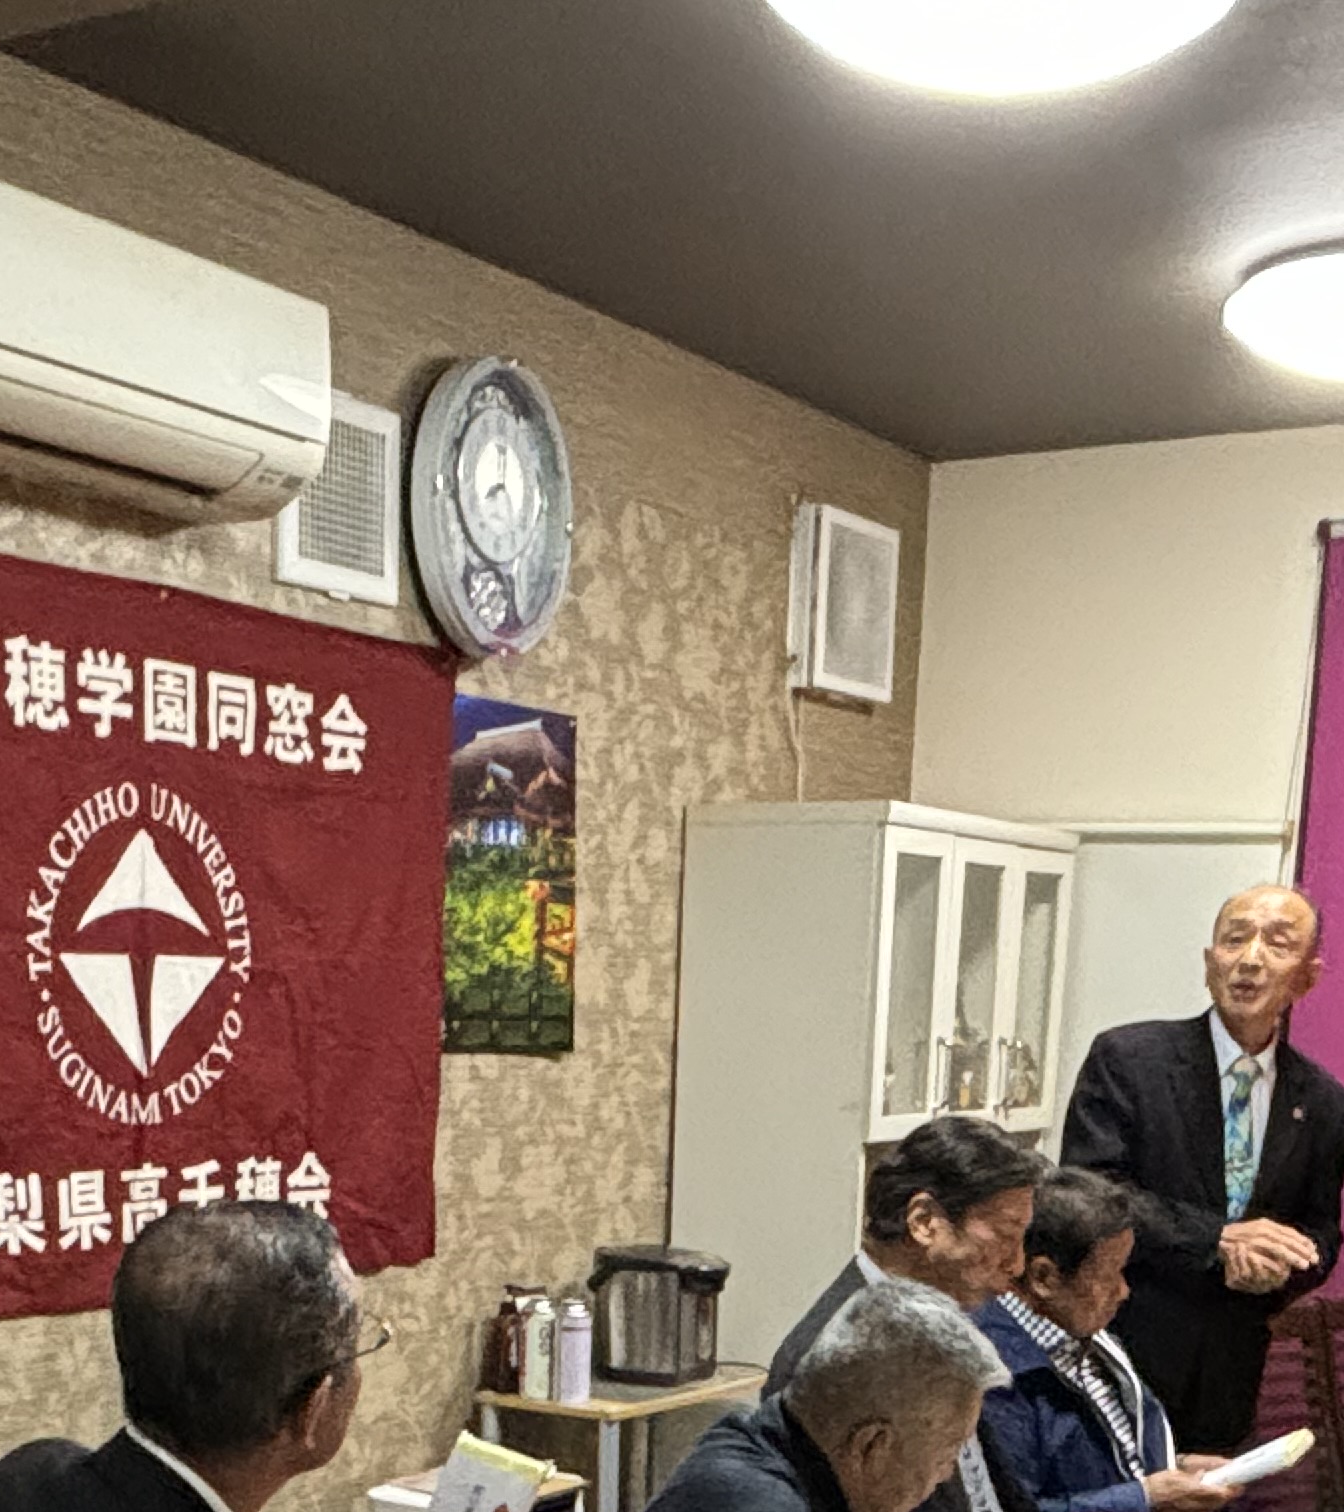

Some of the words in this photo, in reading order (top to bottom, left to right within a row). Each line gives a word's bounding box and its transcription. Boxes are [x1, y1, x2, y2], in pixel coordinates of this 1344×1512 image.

[27, 782, 139, 981] TAKACHIHO
[150, 783, 251, 984] UNIVERSITY
[164, 1010, 243, 1116] TOKYO
